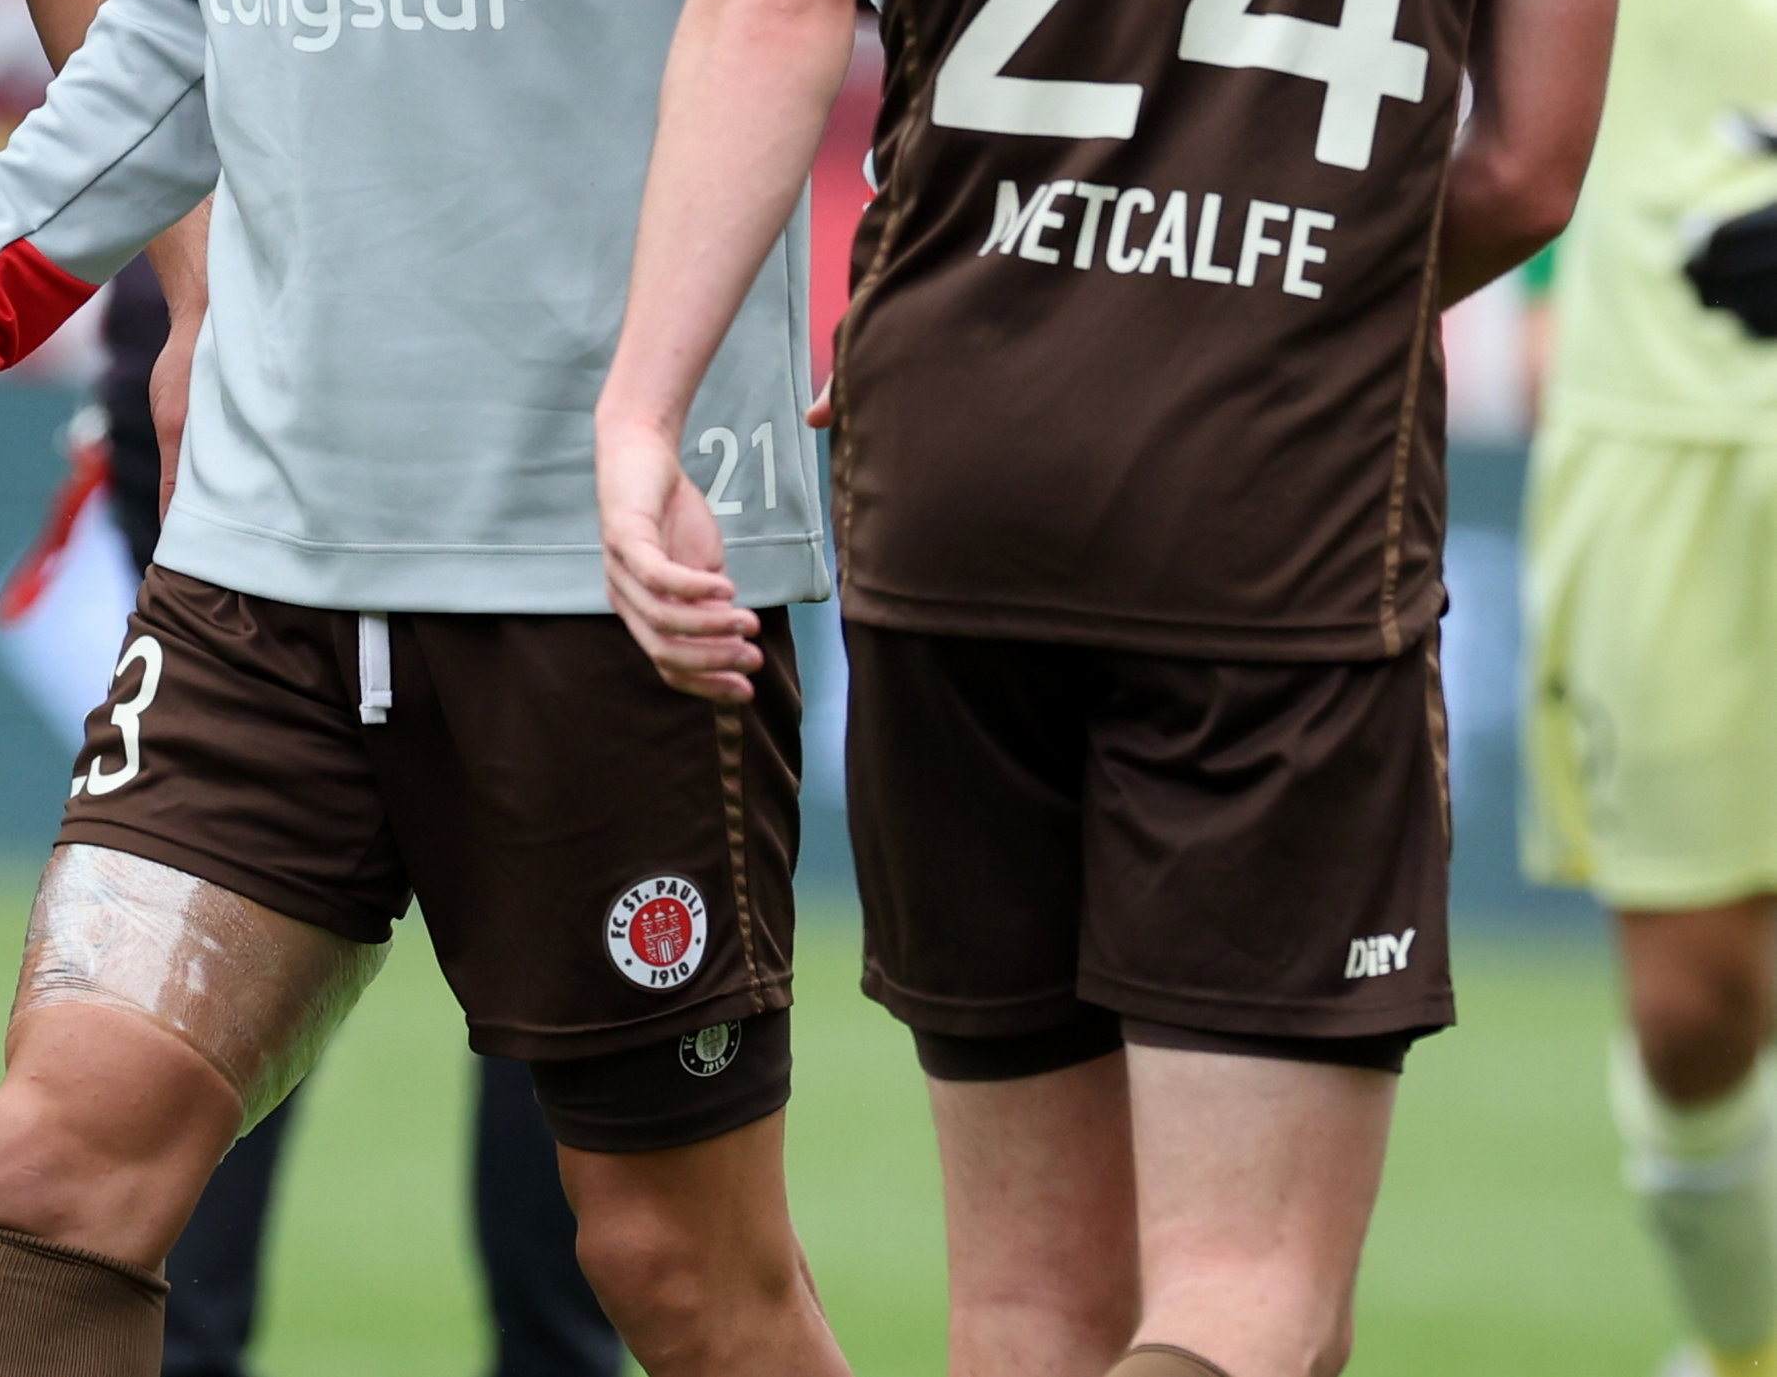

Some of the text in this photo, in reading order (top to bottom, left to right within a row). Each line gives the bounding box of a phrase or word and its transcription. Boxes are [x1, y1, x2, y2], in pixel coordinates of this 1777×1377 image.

[977, 179, 1336, 300] METCALFE
[698, 421, 777, 517] 21
[70, 634, 164, 800] 3
[610, 880, 703, 939] FC ST. PAULI
[650, 961, 690, 985] 1910
